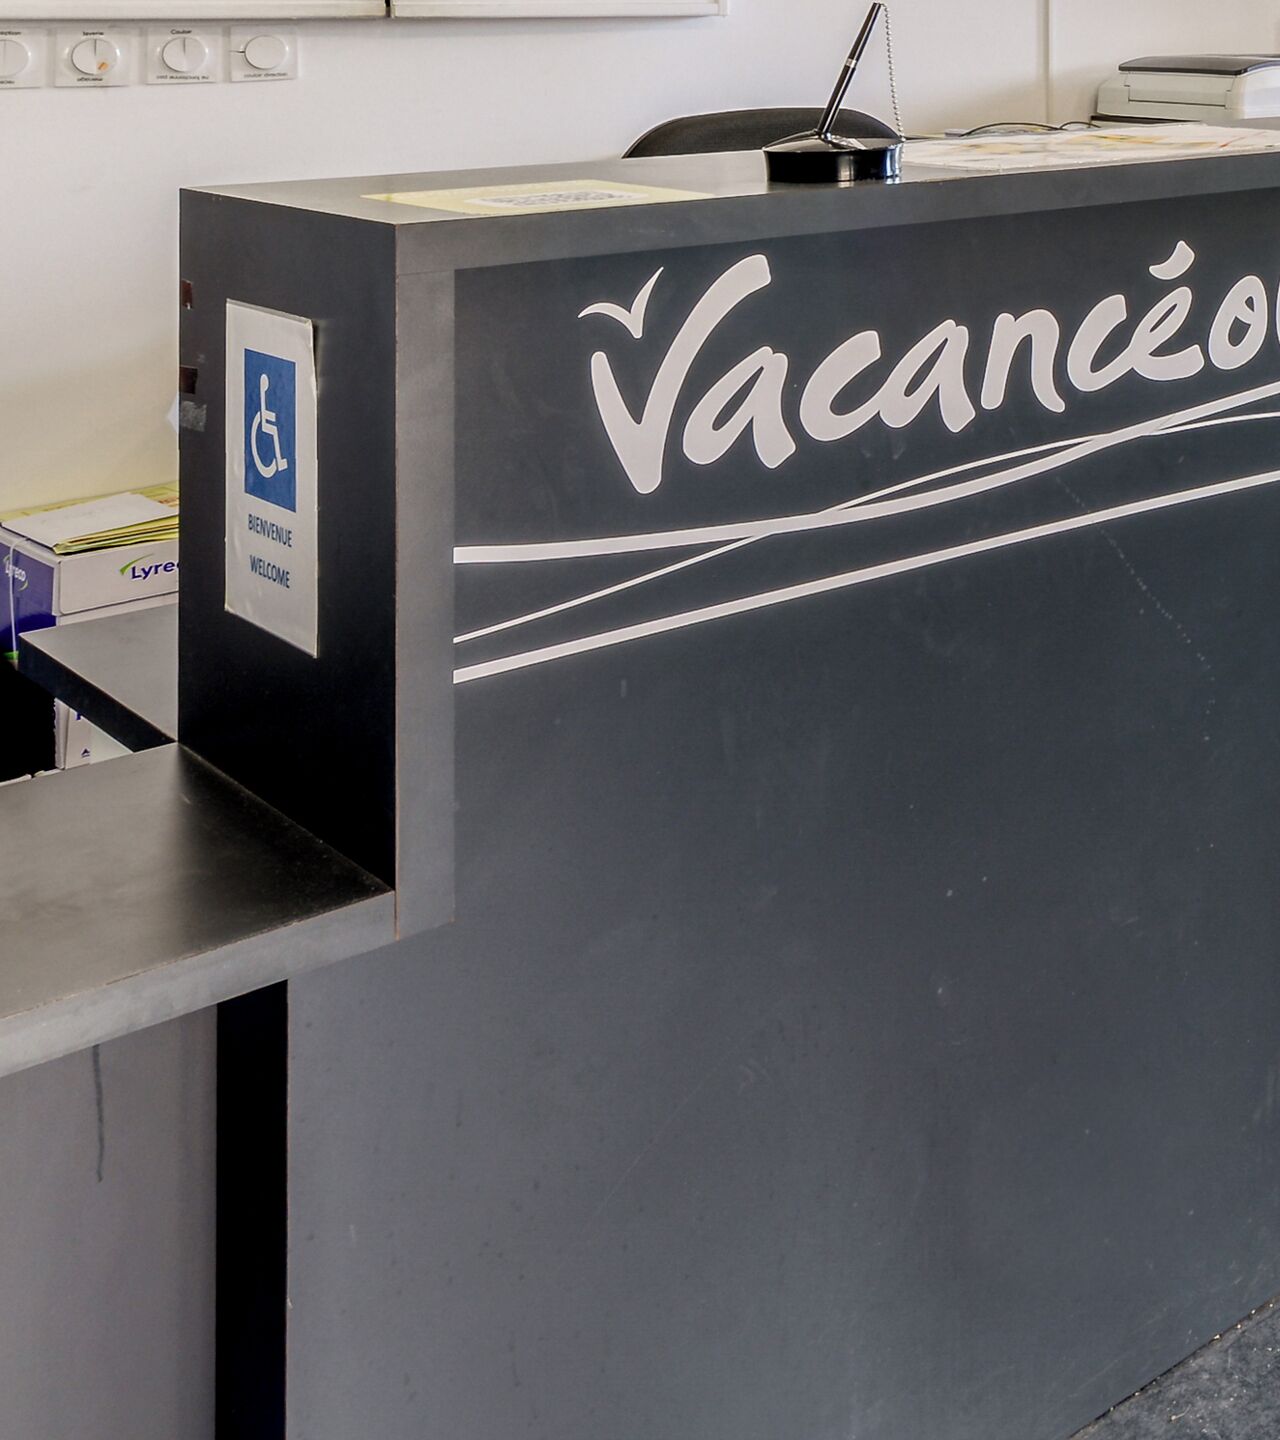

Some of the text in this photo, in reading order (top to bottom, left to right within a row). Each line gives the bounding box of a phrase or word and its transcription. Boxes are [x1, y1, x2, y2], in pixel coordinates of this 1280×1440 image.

[248, 513, 292, 548] BIENVENUE
[131, 560, 179, 582] Lyre
[250, 554, 291, 590] WELCOME
